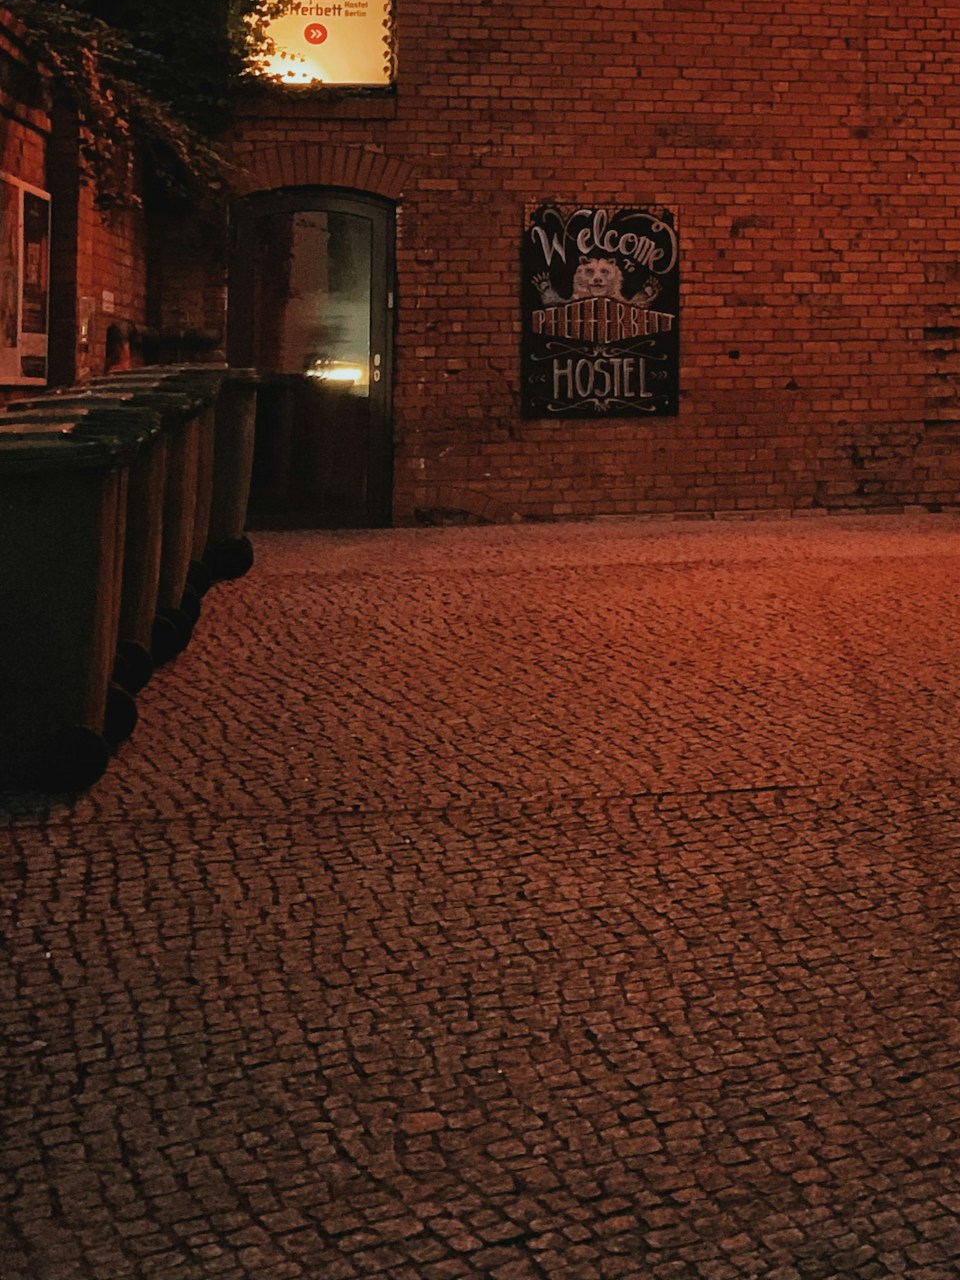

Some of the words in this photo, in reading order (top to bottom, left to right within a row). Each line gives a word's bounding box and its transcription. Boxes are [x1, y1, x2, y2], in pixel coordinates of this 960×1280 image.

[344, 1, 369, 9] Hostel
[344, 10, 367, 18] Berlin
[531, 208, 678, 275] Welcome
[531, 297, 676, 344] PFEFFERBETT
[552, 357, 654, 400] HOSTEL
